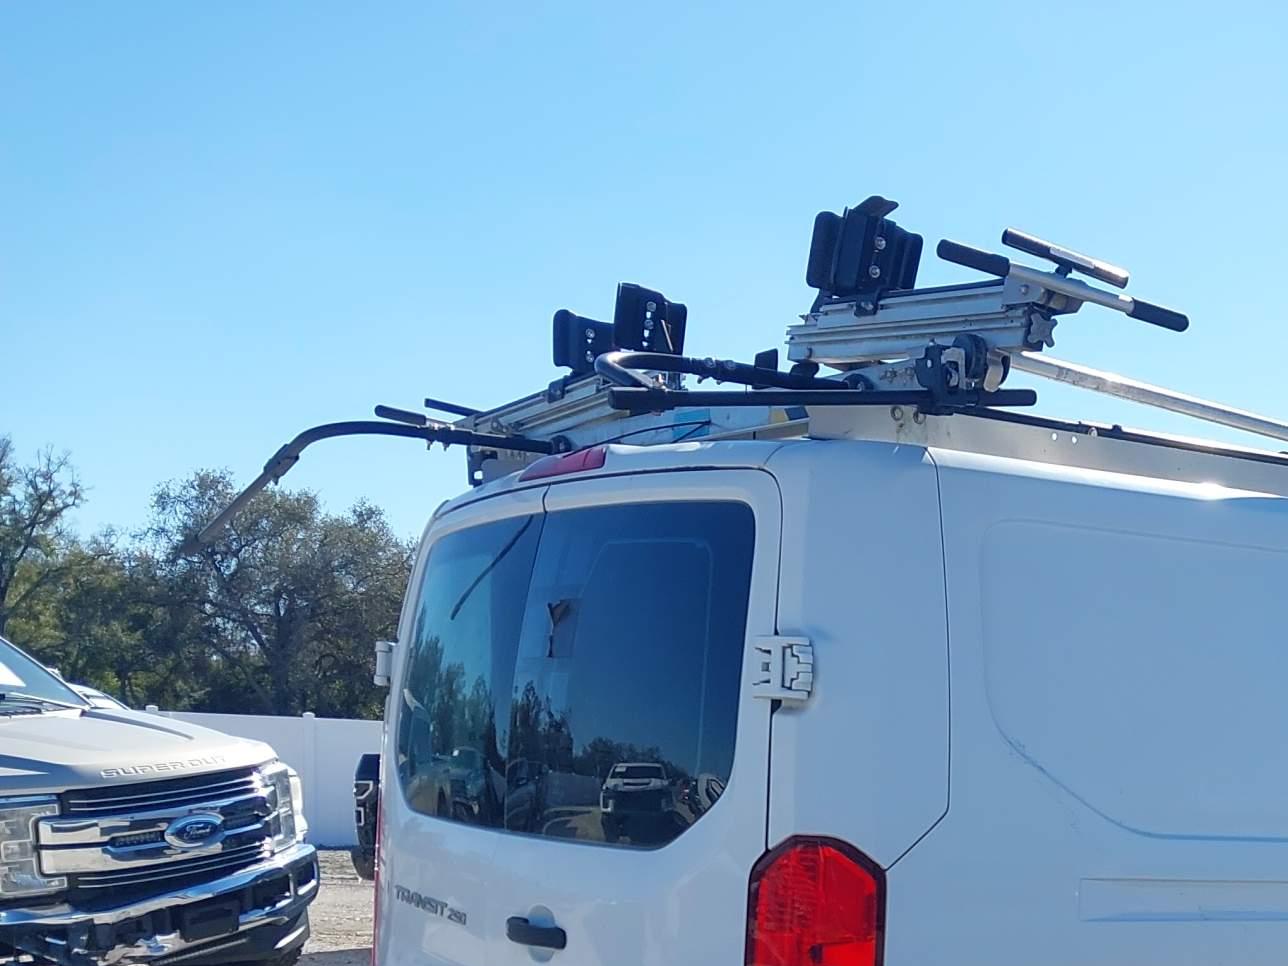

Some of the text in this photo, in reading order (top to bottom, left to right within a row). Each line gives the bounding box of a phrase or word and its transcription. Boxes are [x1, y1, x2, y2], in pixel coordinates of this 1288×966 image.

[100, 761, 186, 779] SUPER
[183, 823, 212, 840] Ford
[394, 884, 448, 917] TRANSIT
